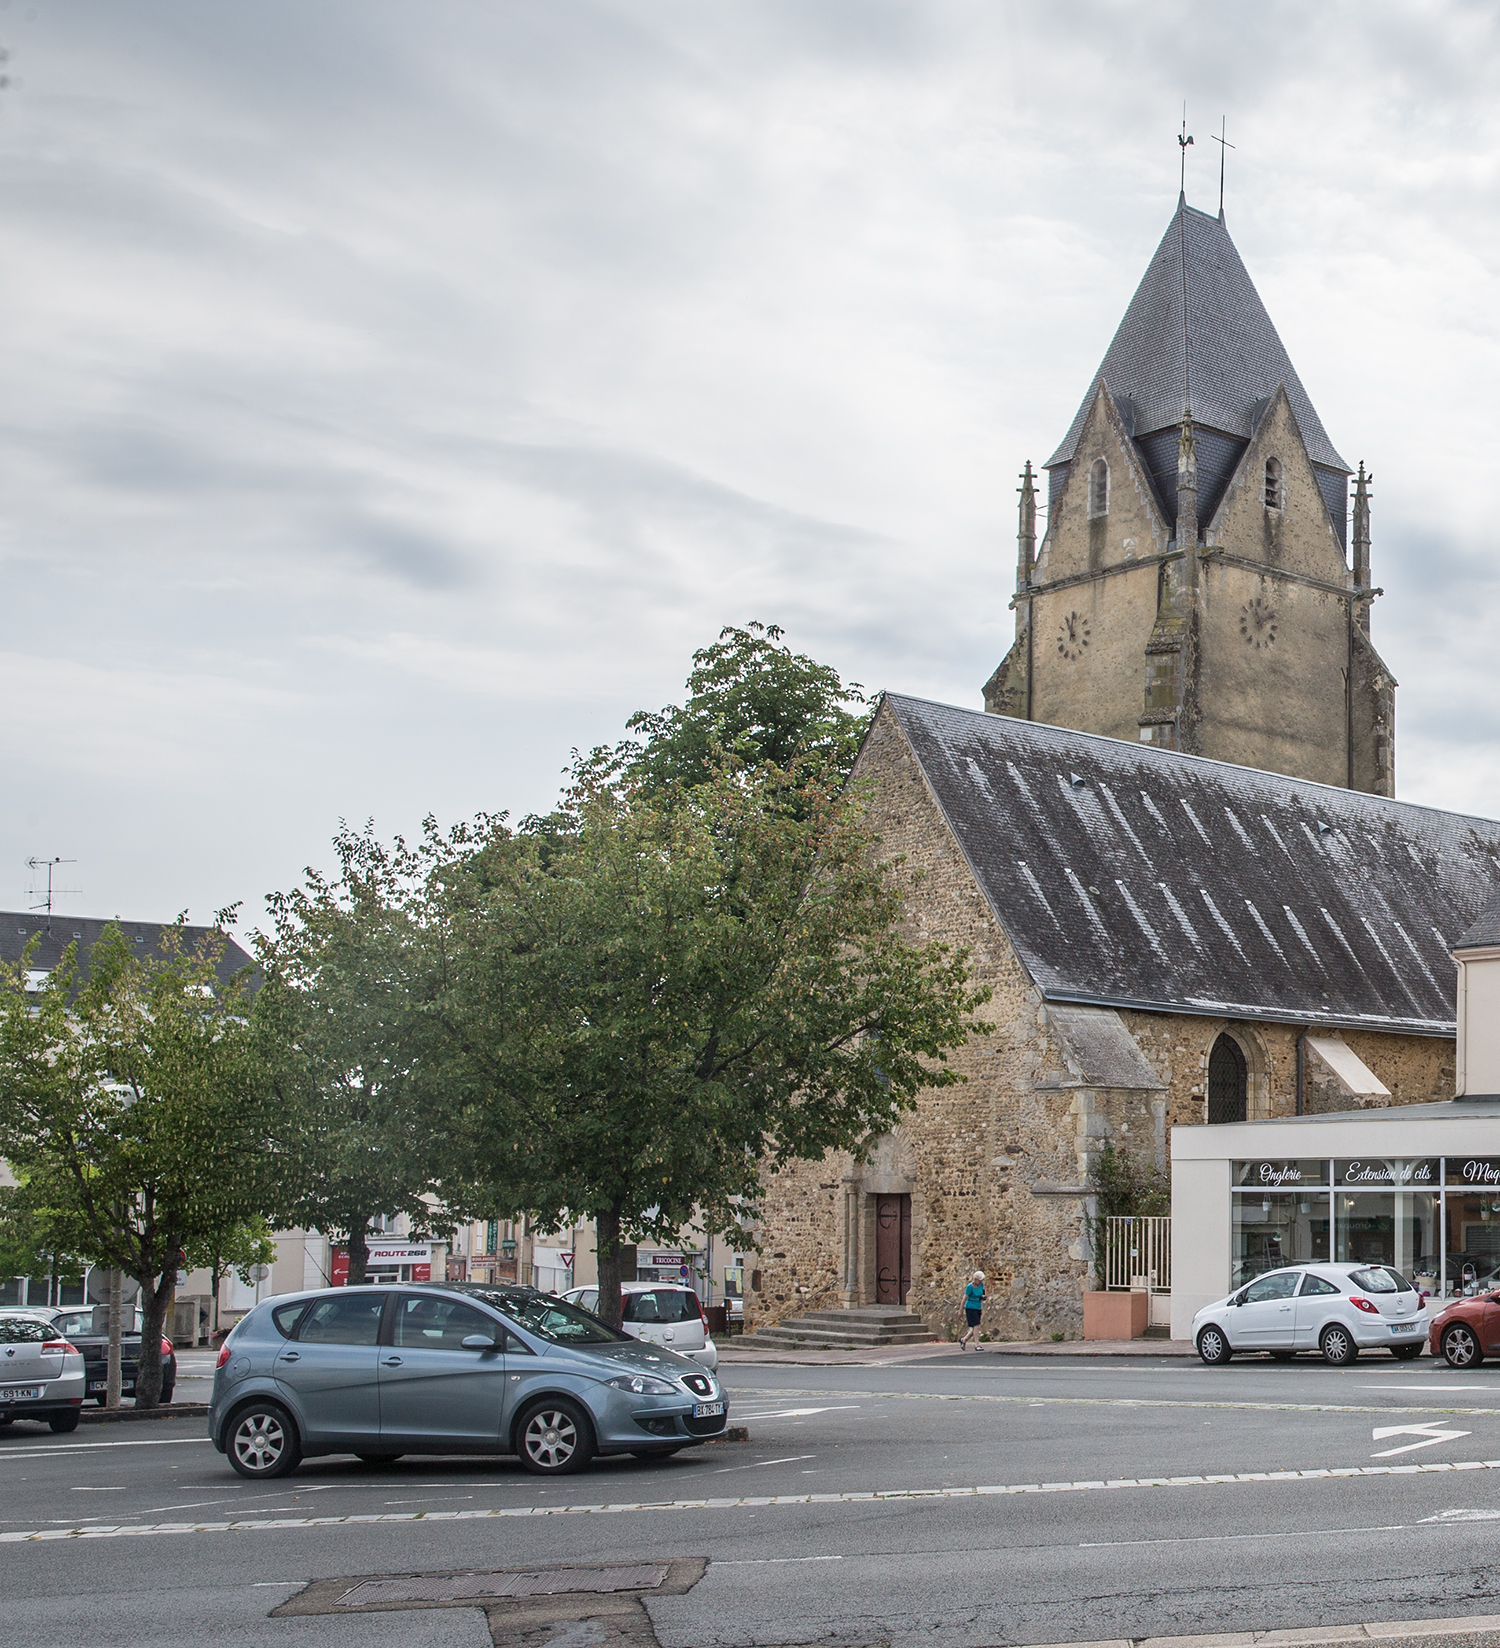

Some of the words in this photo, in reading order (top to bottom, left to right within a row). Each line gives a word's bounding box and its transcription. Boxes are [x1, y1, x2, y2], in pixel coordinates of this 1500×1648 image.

[1259, 1162, 1302, 1187] Onglerie
[1345, 1162, 1397, 1182] Extension
[1400, 1165, 1412, 1181] de
[1414, 1164, 1431, 1181] cils
